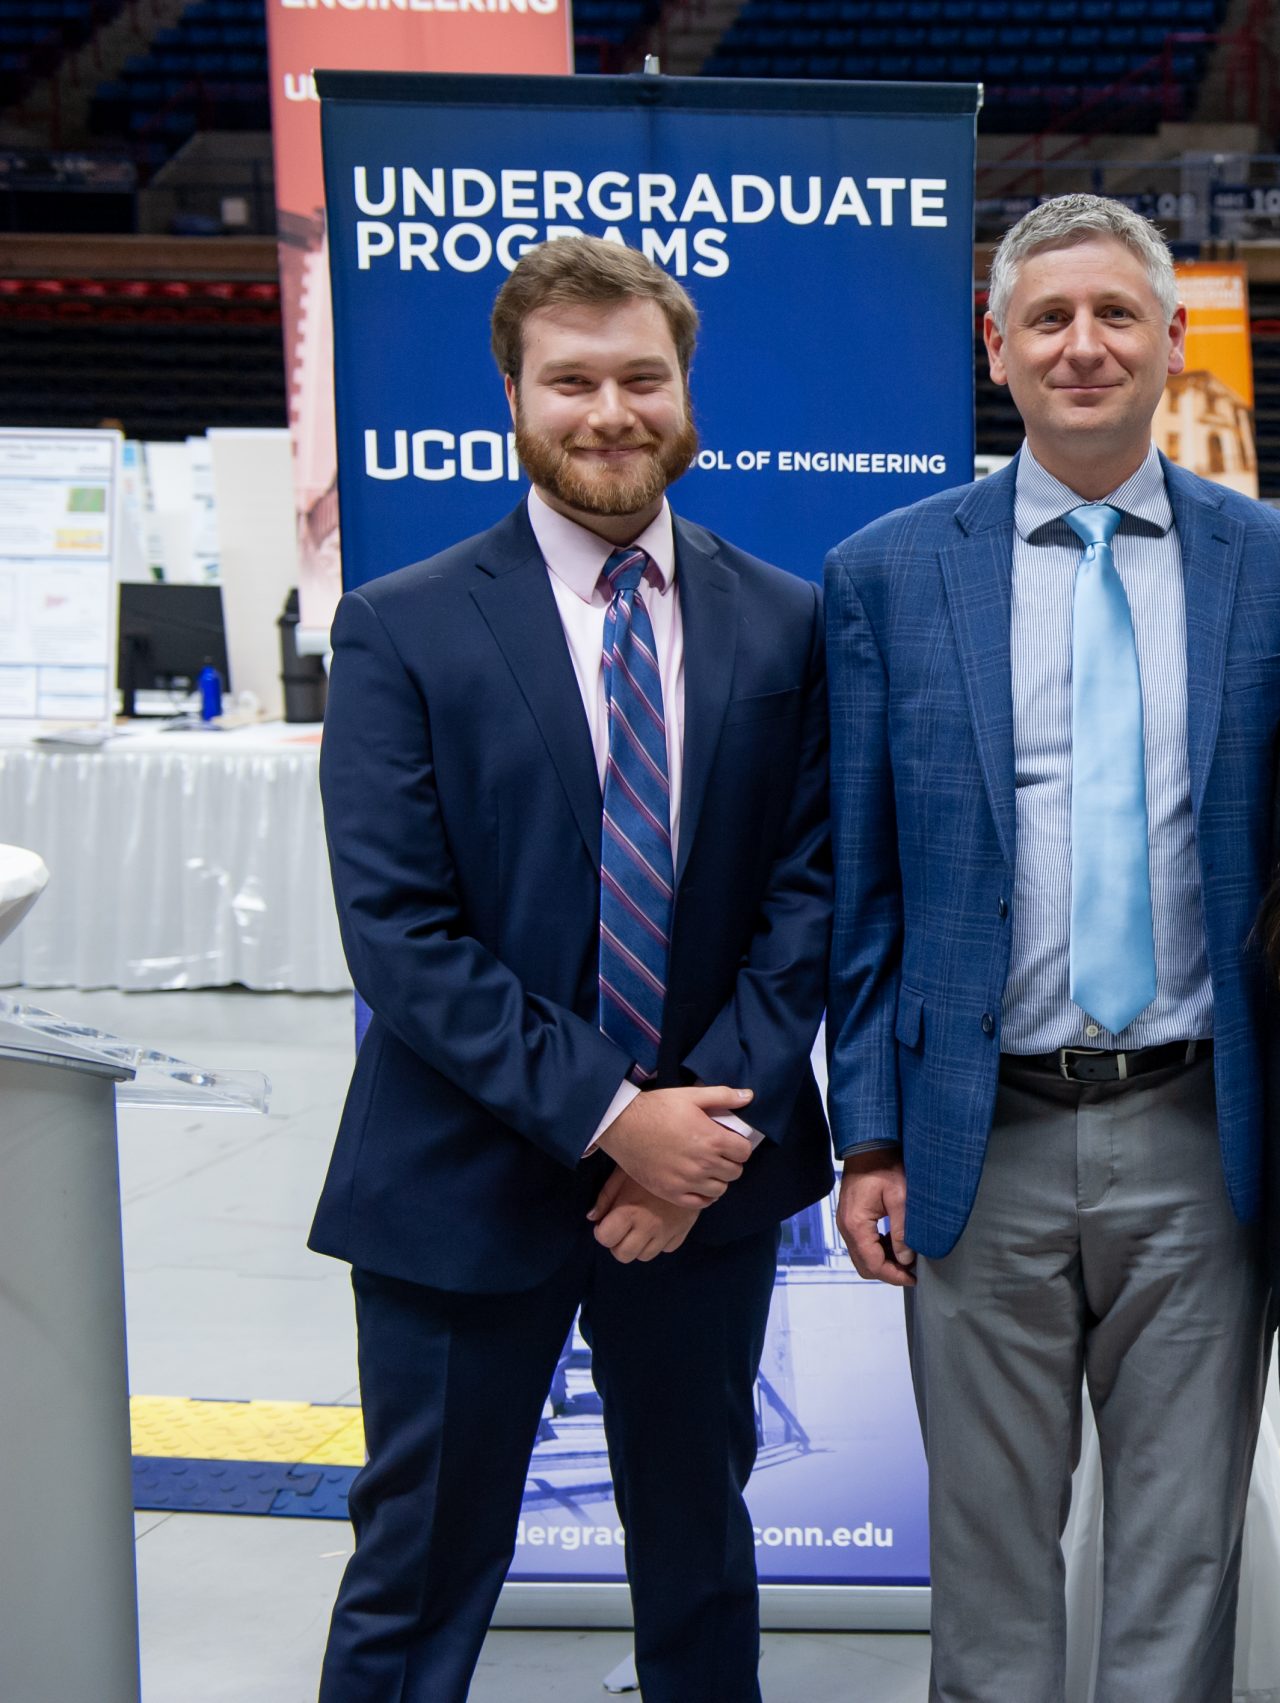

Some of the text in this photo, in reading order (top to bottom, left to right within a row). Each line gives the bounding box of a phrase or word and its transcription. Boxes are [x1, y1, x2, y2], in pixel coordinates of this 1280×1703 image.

[354, 166, 948, 227] UNDERGRADUATE
[736, 450, 771, 470] OF
[778, 451, 946, 474] ENGINEERING
